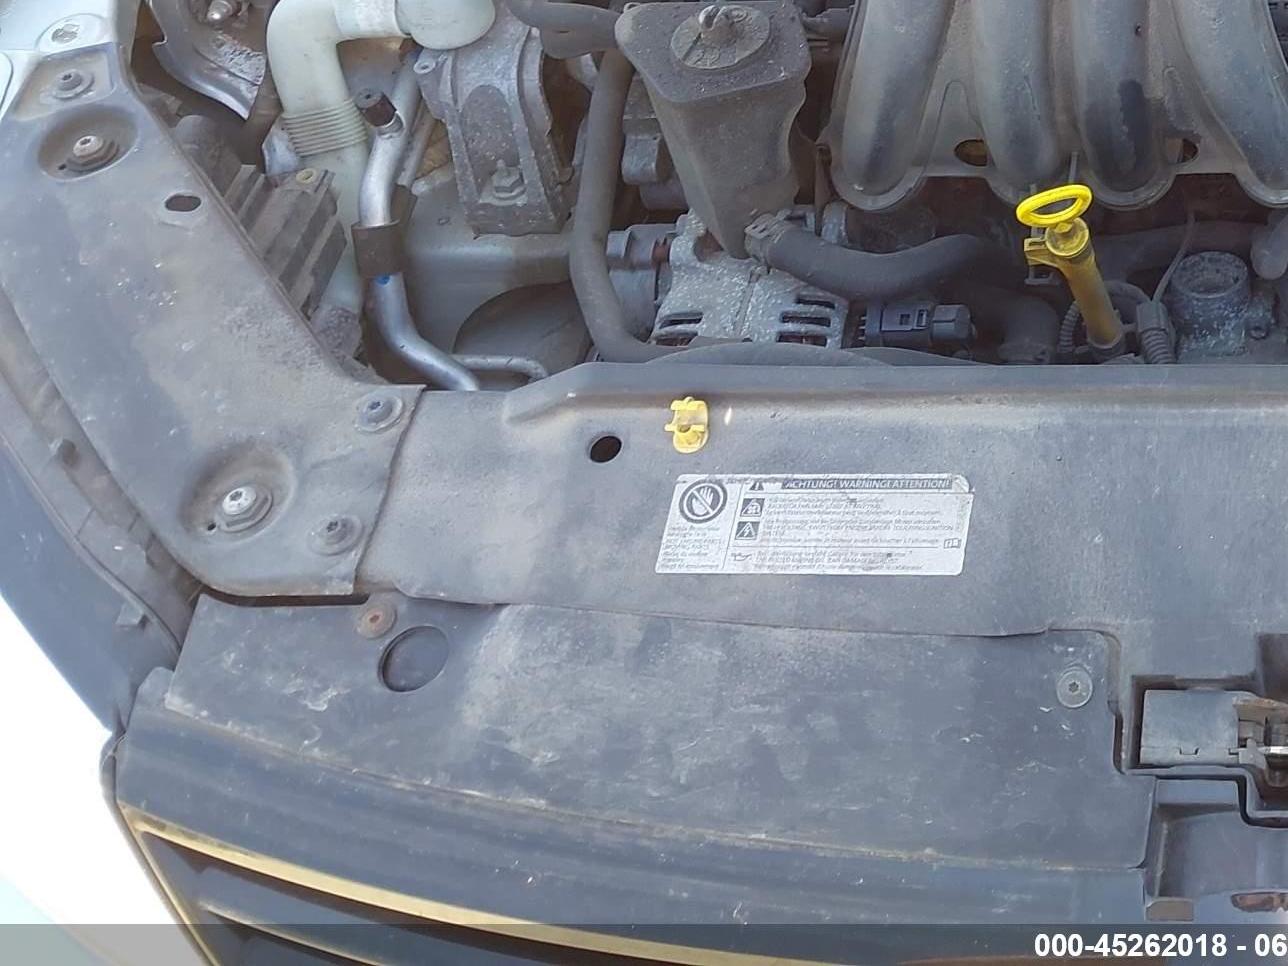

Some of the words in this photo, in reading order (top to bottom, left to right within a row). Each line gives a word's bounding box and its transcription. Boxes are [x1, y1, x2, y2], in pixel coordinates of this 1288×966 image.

[785, 477, 838, 489] ACHTUNG!
[839, 478, 892, 489] WARNING!
[892, 478, 951, 489] ATTENTION!
